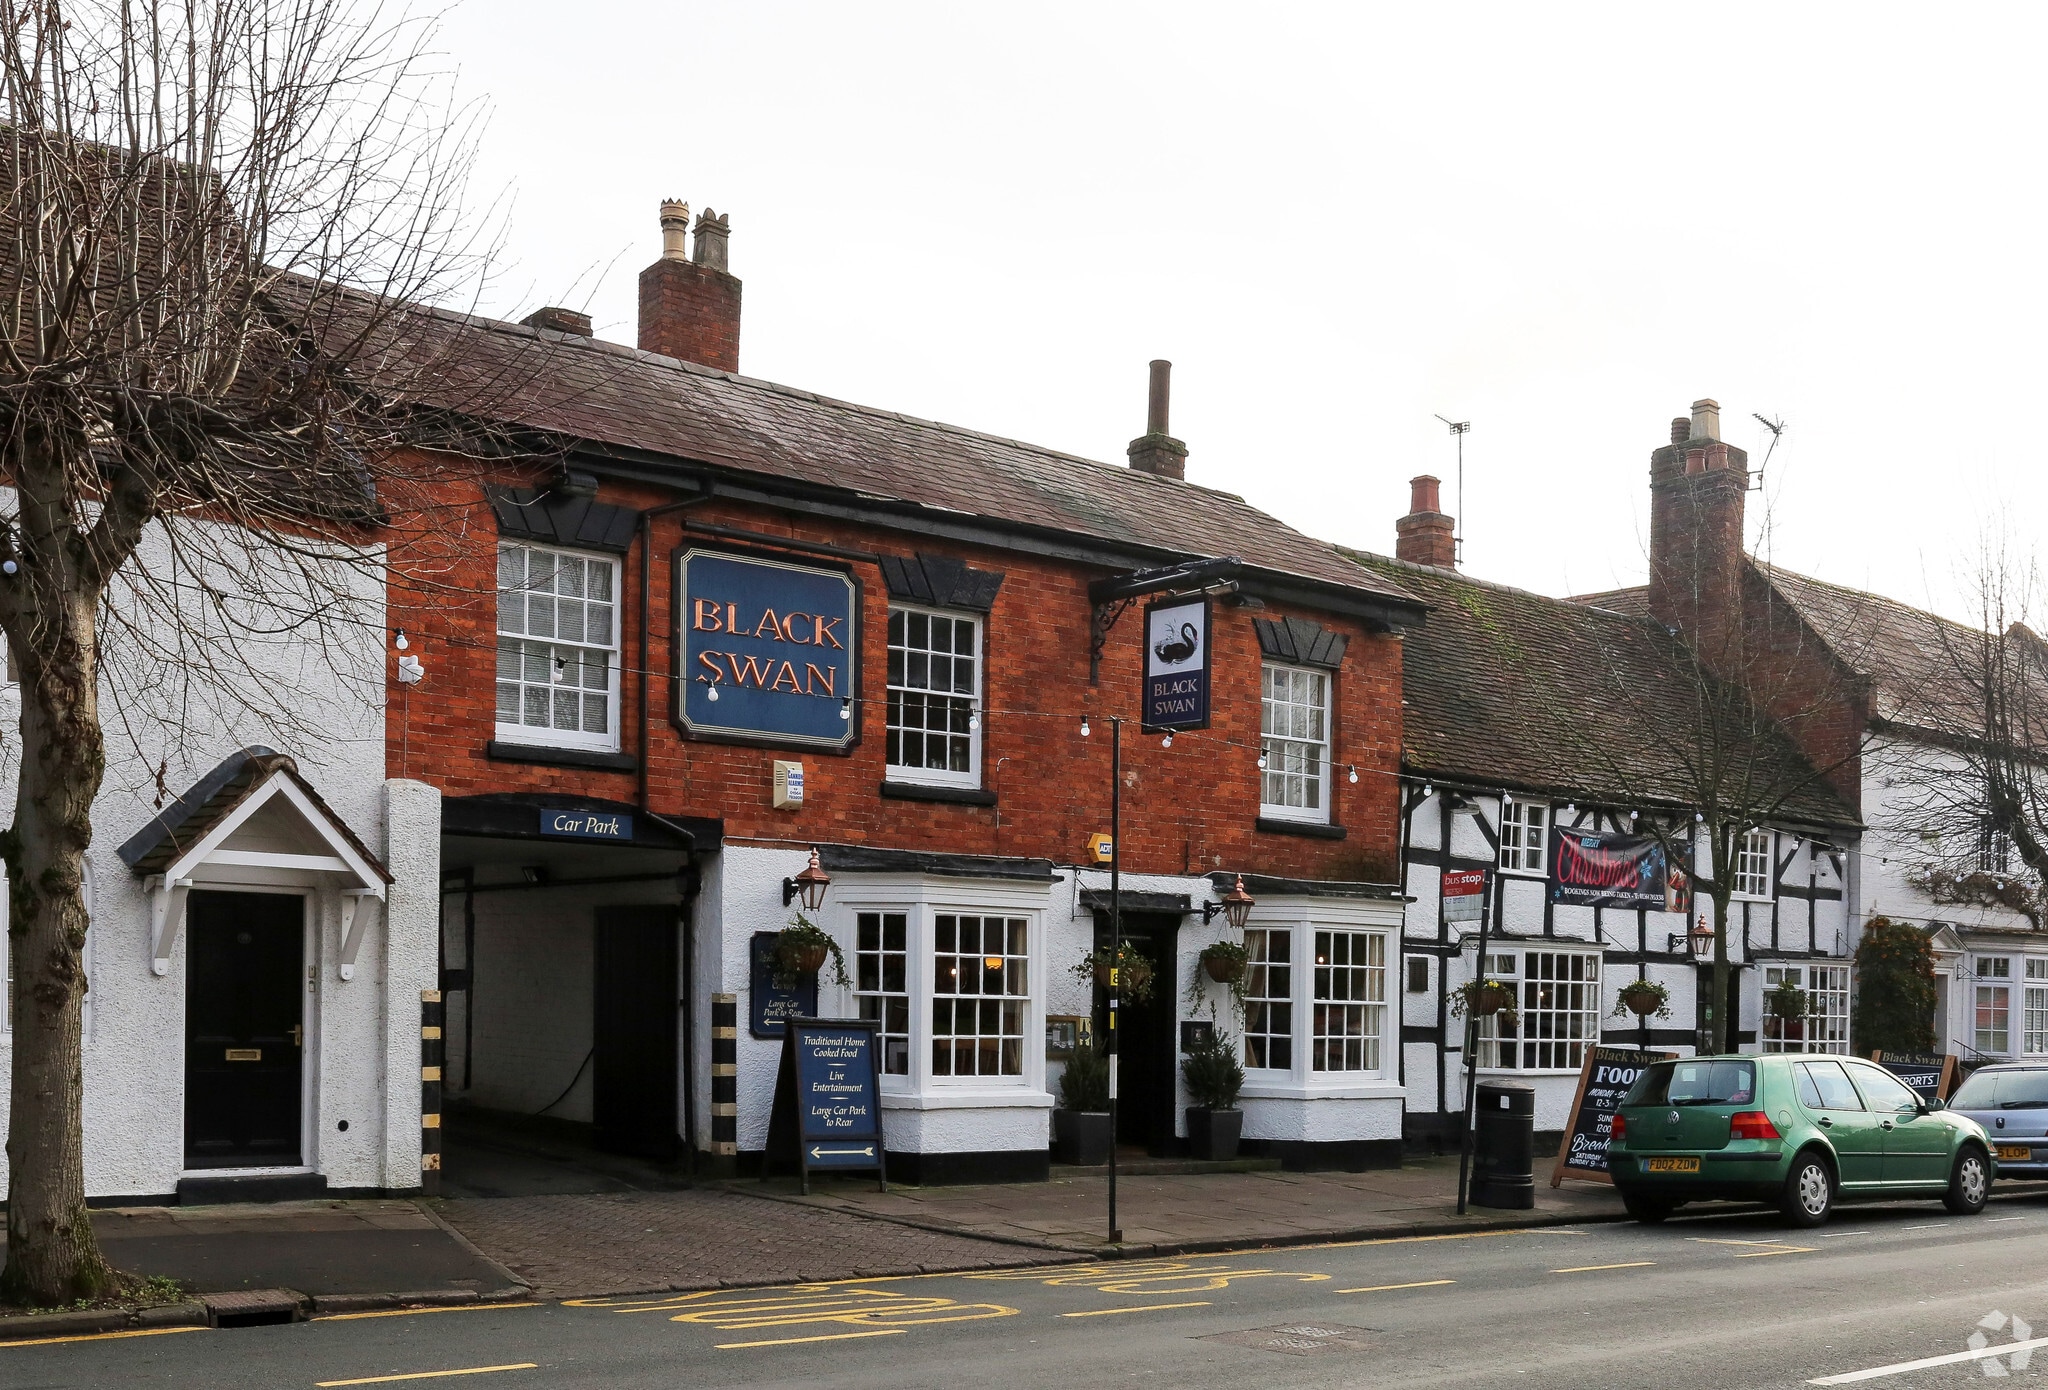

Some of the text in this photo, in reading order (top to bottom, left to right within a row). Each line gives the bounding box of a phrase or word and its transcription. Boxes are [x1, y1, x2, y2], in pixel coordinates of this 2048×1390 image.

[692, 597, 844, 650] BLACK
[696, 650, 836, 697] SWAN
[1154, 679, 1198, 697] BLACK
[1155, 698, 1195, 715] SWAN
[554, 815, 619, 835] Car Park
[1580, 837, 1600, 848] MERRY
[1557, 834, 1639, 889] Christmas
[1445, 874, 1482, 885] bus stop
[1564, 887, 1589, 896] BOOKINGS
[768, 1000, 799, 1012] Large Car
[763, 1008, 780, 1016] Park
[804, 1035, 866, 1047] Traditional Home
[813, 1047, 858, 1058] Cooked Food
[1595, 1048, 1628, 1062] Black
[1882, 1052, 1943, 1066] Black Swan
[829, 1071, 845, 1081] Live
[812, 1082, 862, 1092] Entertainment
[1588, 1088, 1615, 1098] MONDAY
[811, 1105, 866, 1119] Large Car Park
[826, 1117, 854, 1127] to Rear
[1575, 1152, 1602, 1161] SATURDAY
[2006, 1148, 2028, 1158] LOP
[1569, 1157, 1589, 1166] SUNDAY
[1650, 1159, 1674, 1170] FD02
[560, 1285, 1021, 1330] STOP
